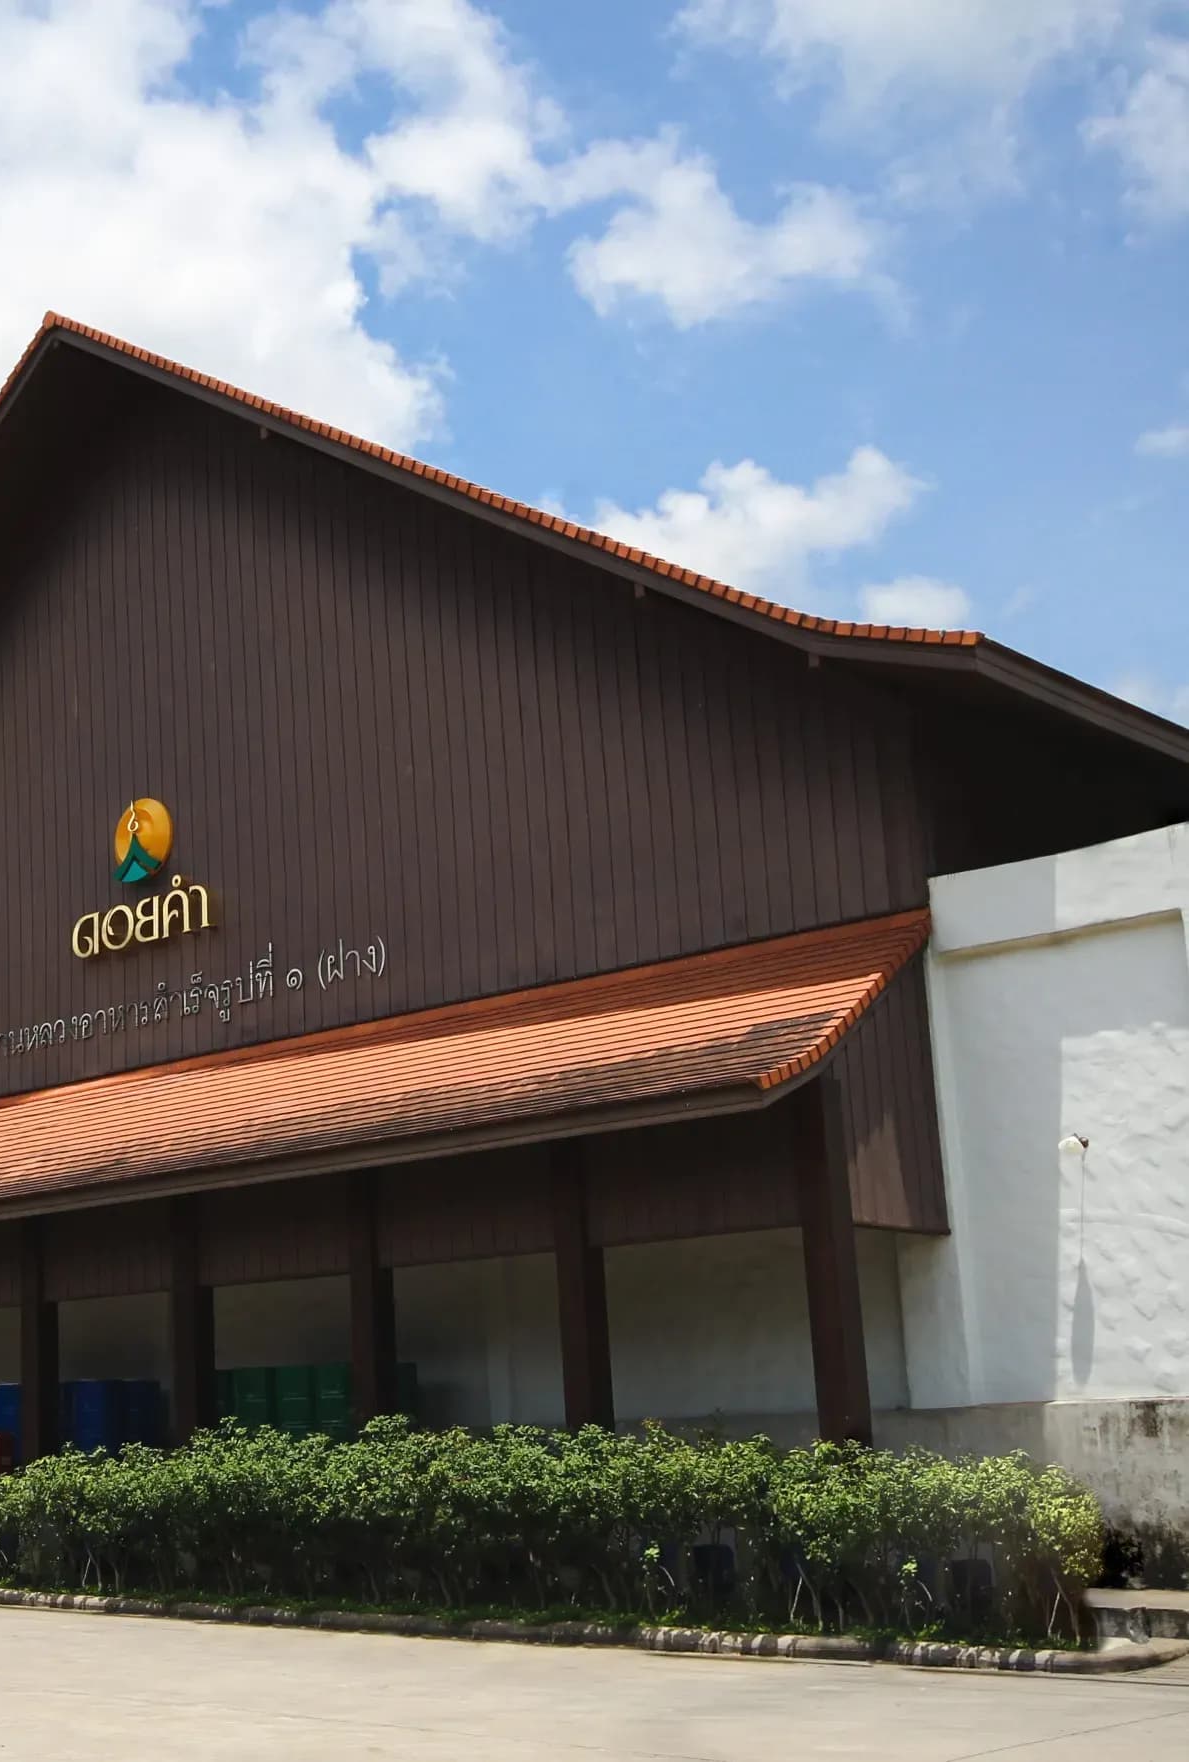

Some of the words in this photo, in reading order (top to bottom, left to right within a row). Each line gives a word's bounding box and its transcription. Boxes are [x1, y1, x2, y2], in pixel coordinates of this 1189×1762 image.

[72, 874, 211, 959] ดอยคำ
[286, 968, 303, 990] ๑
[318, 936, 386, 990] (ฝาง)
